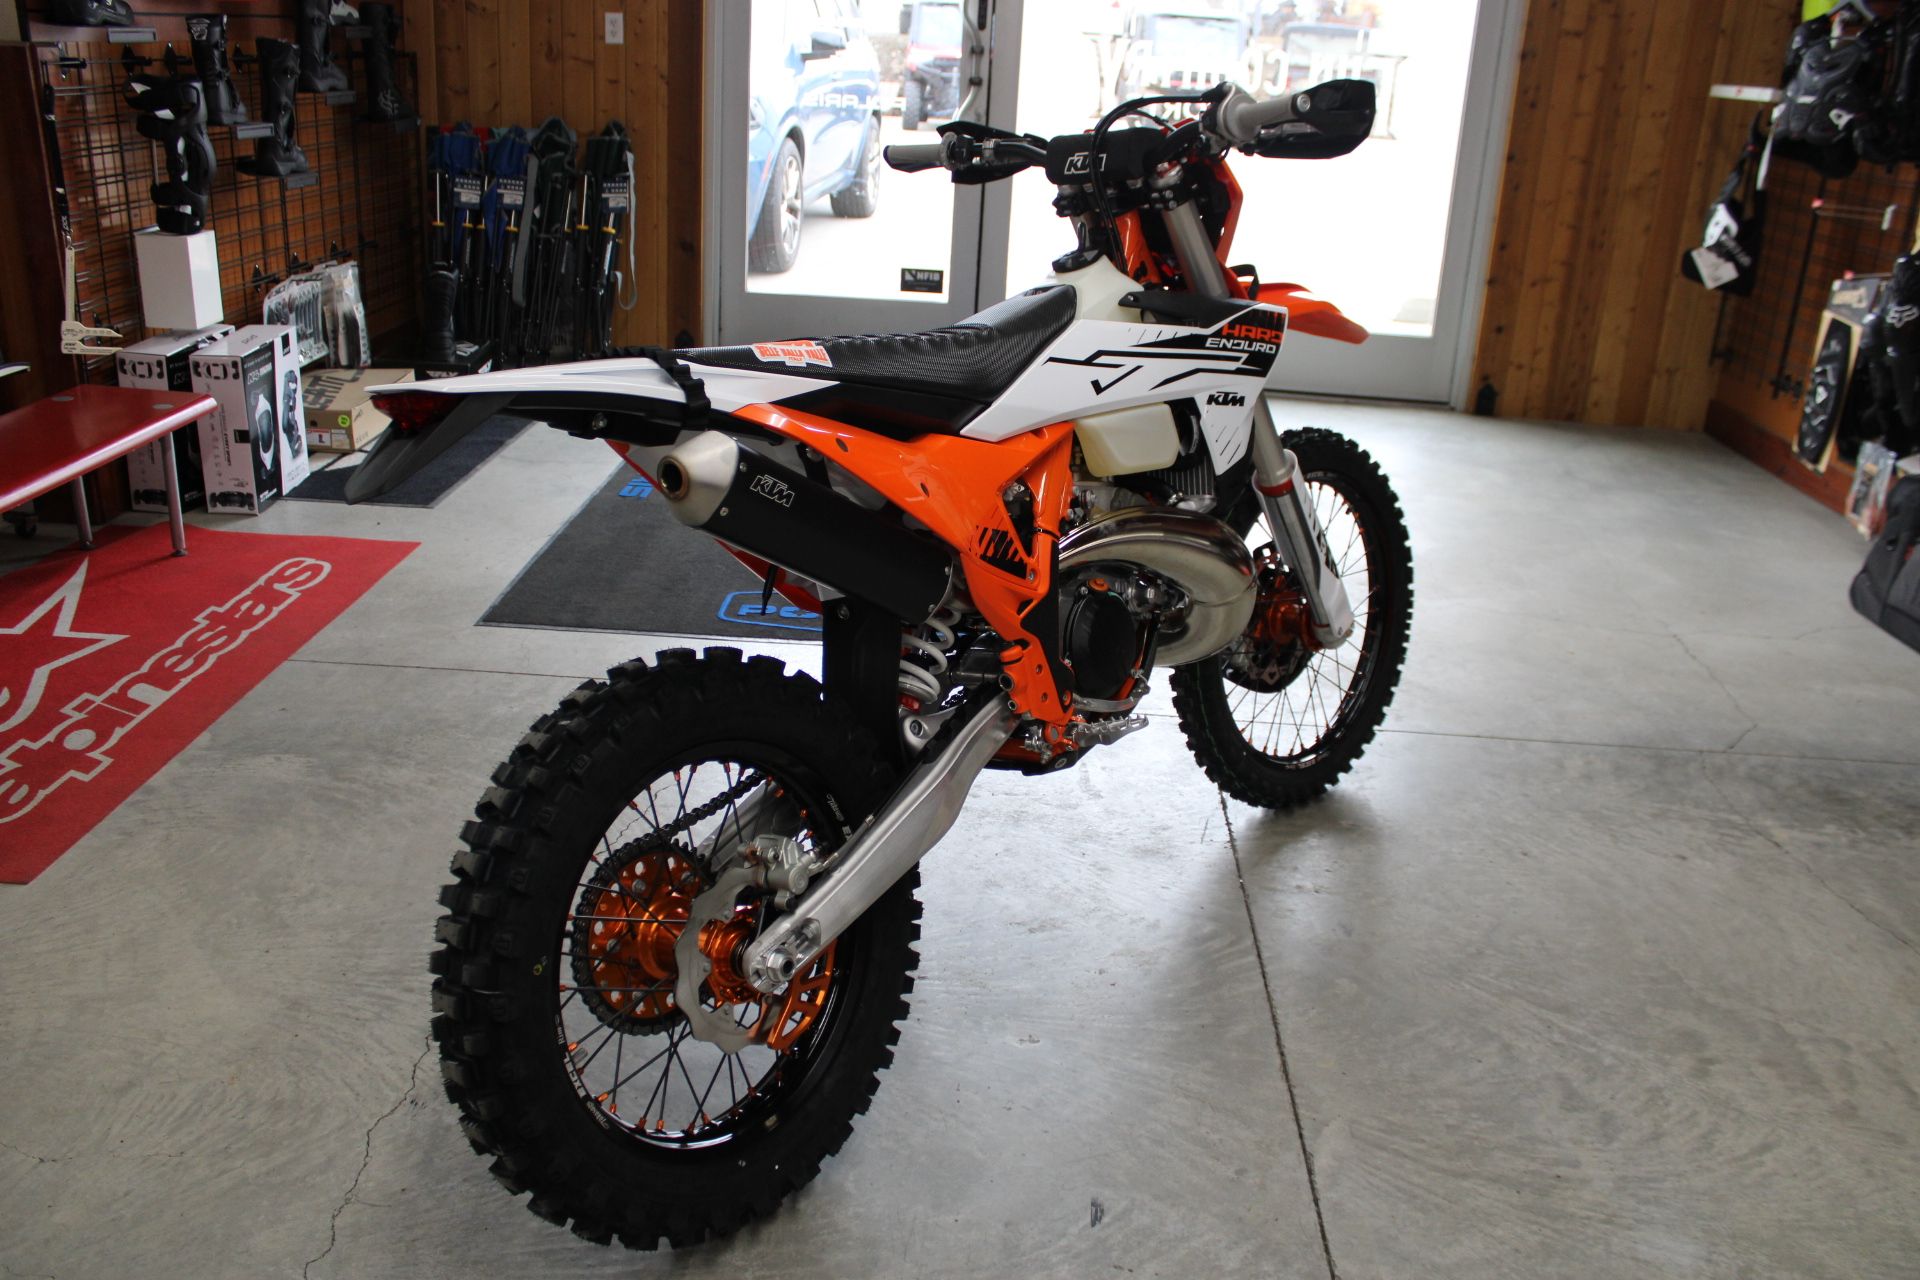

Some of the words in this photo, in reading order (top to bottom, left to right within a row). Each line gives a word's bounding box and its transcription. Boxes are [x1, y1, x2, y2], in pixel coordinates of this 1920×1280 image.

[1222, 323, 1284, 344] HARD
[1205, 337, 1276, 354] ENDURO
[1206, 391, 1246, 407] KTM
[749, 474, 795, 507] KTM
